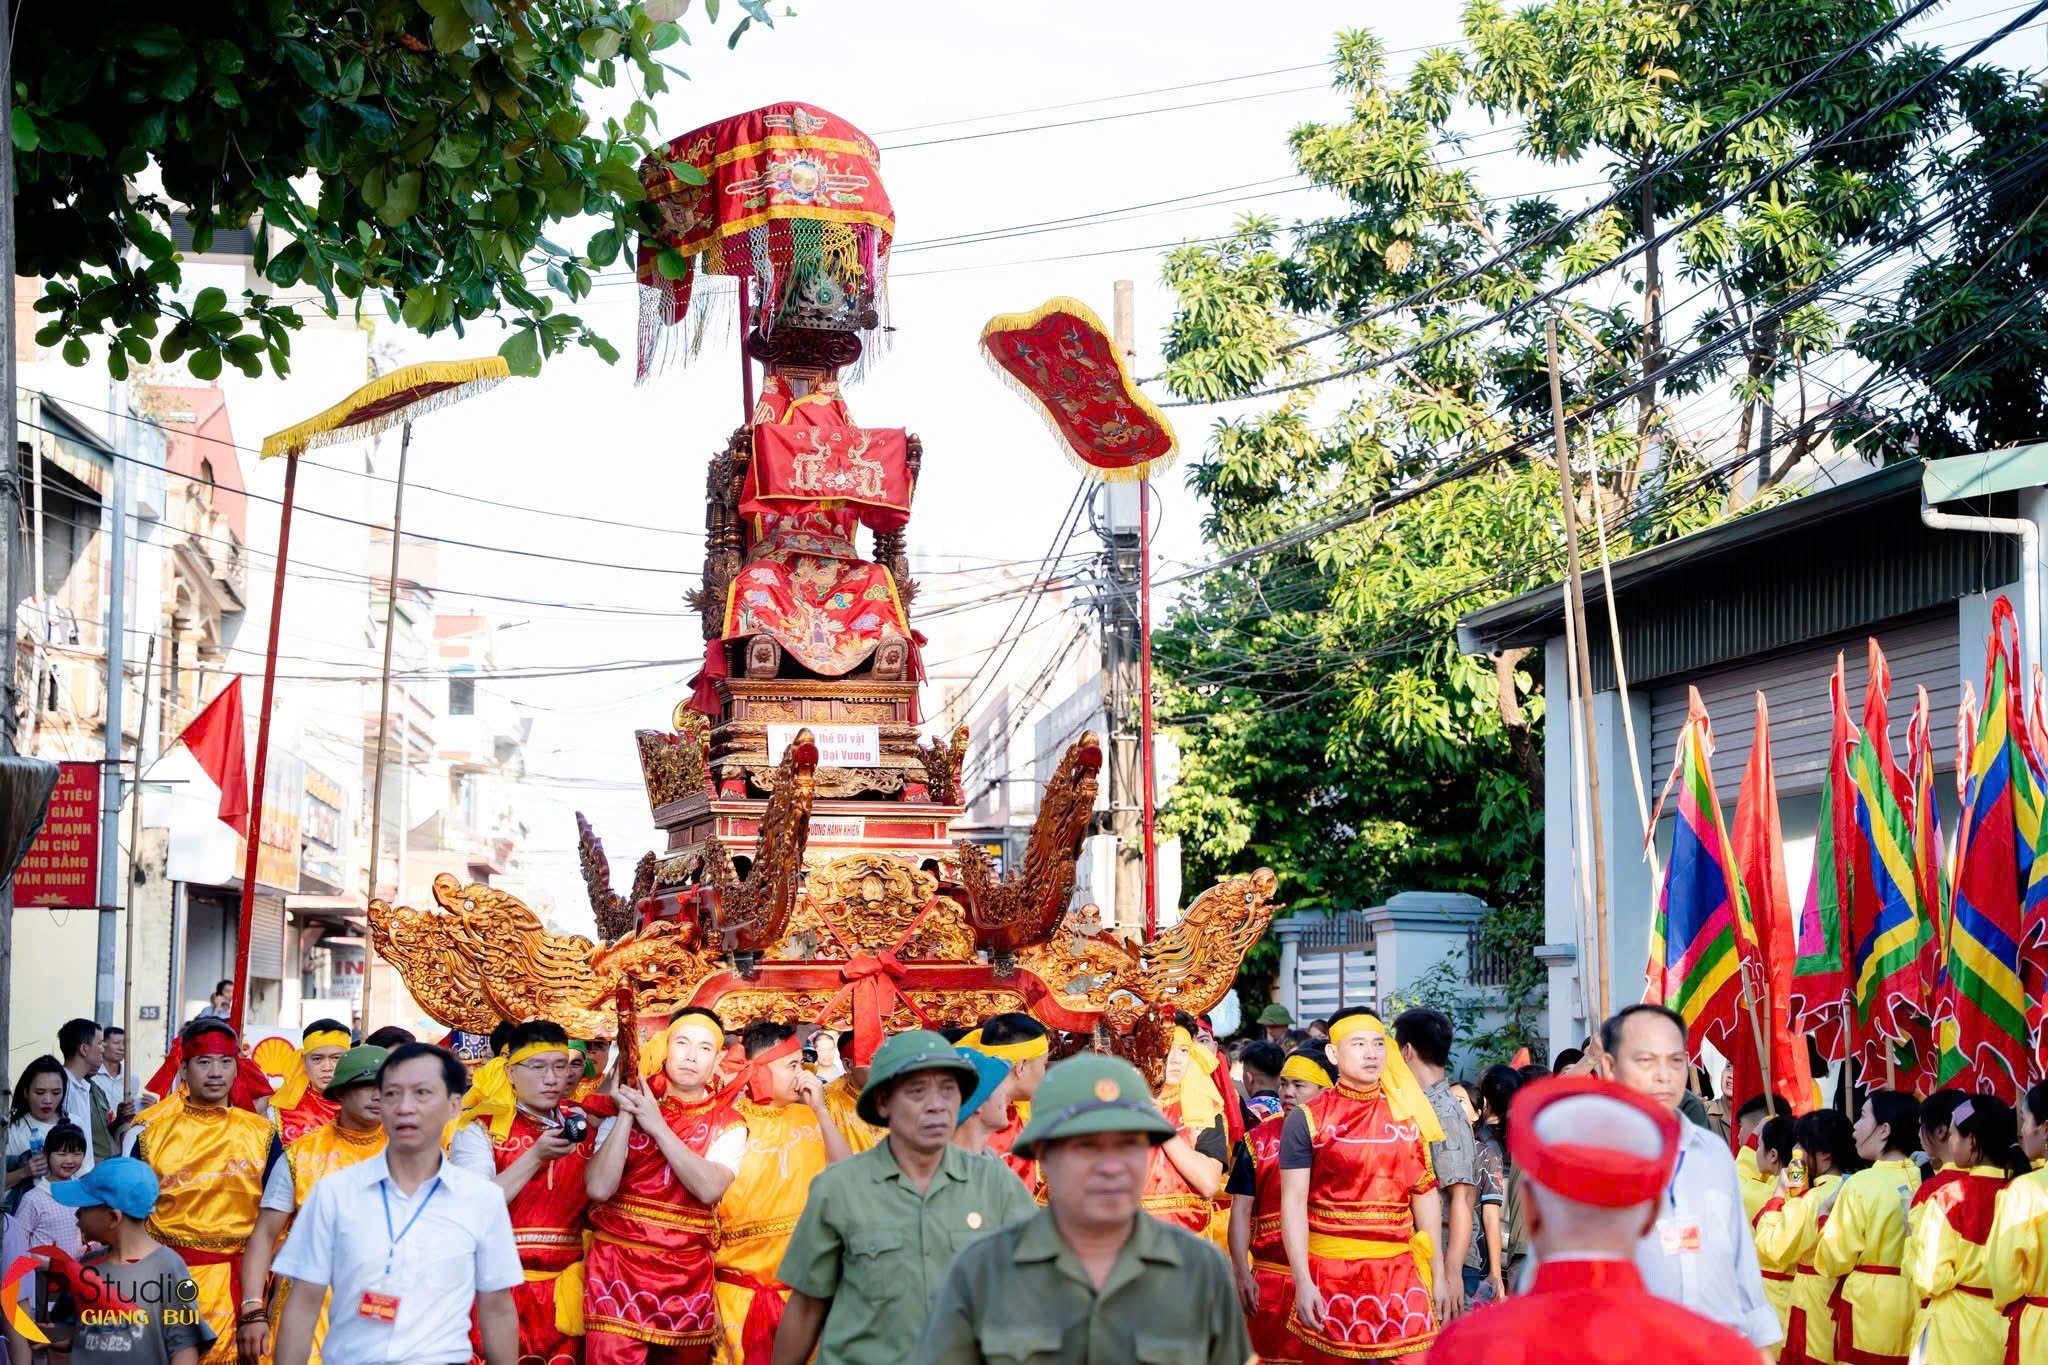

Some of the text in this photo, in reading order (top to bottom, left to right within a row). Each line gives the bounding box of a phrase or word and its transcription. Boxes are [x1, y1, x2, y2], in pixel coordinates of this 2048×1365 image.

[63, 789, 92, 801] TIÊU
[51, 806, 84, 818] GIÀU
[51, 823, 92, 836] MẠNH
[52, 836, 80, 851] CHỦ
[21, 855, 49, 868] ÔNG
[44, 873, 86, 885] MINH!
[142, 1006, 157, 1019] 35
